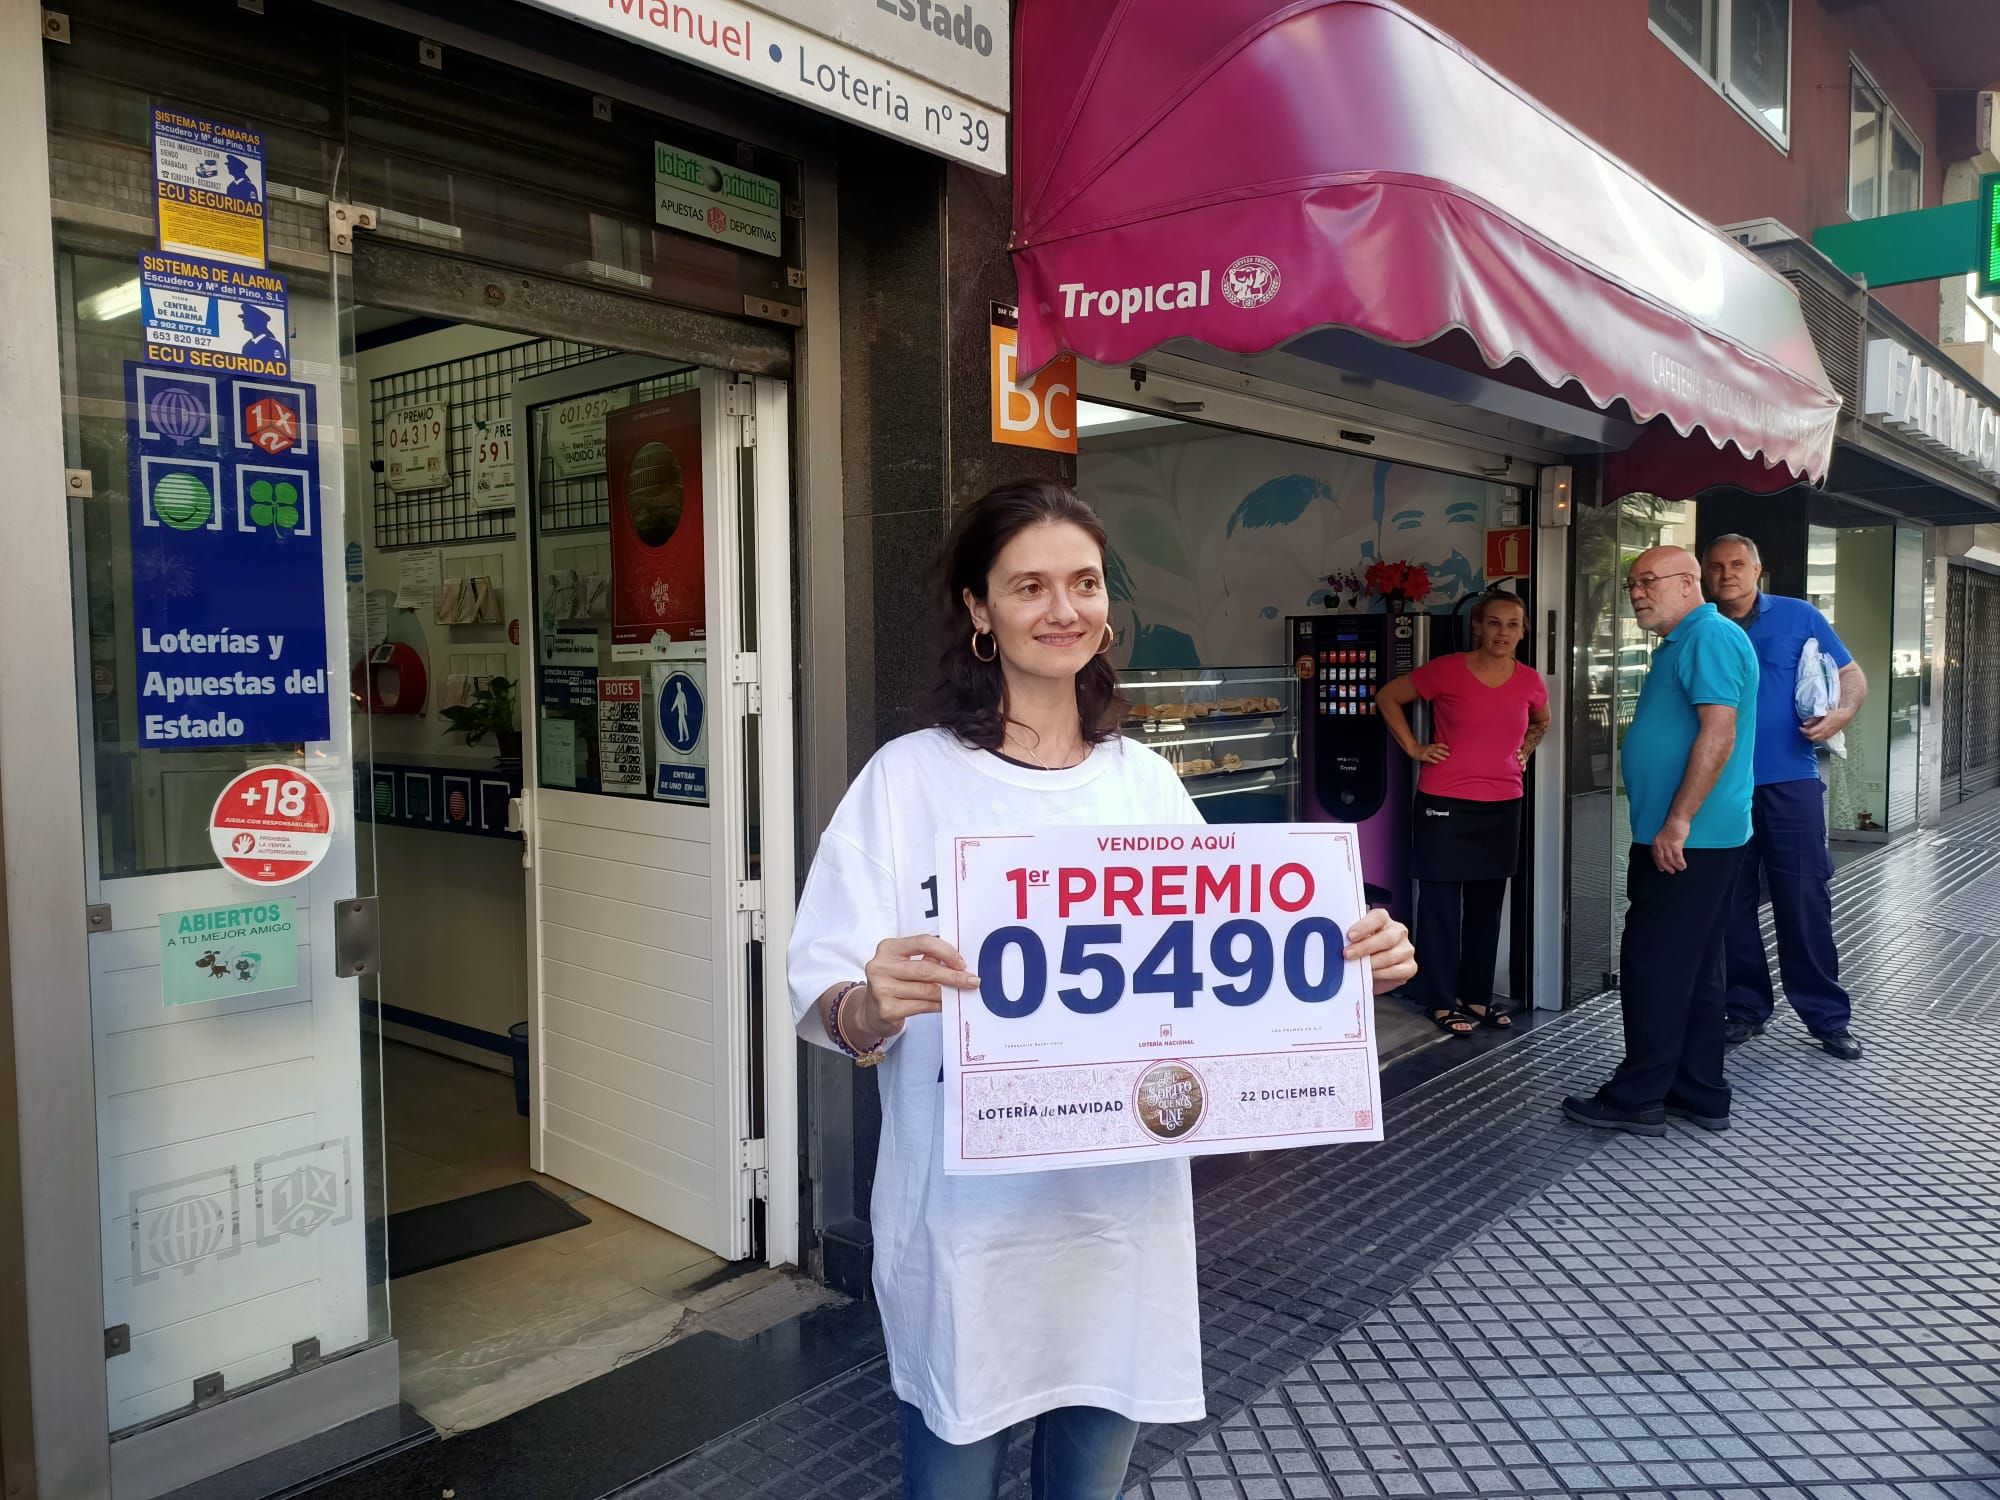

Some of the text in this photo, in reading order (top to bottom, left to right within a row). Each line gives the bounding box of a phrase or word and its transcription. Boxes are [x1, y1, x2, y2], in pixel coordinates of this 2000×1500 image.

[800, 45, 910, 123] Loteria
[959, 112, 990, 152] 39
[154, 110, 260, 145] SISTEMA DE CAMARAS
[155, 121, 193, 138] Escudero
[194, 133, 199, 141] y
[212, 135, 225, 145] del
[226, 138, 245, 152] Pino,
[160, 139, 176, 149] ESTAS
[160, 149, 178, 159] SIENDO
[160, 158, 188, 171] GRABADAS
[158, 182, 263, 217] ECU SEGURIDAD
[660, 199, 705, 221] APUESTAS
[729, 219, 778, 242] DEPORTIVAS
[143, 255, 283, 293] SISTEMAS DE ALARMA
[144, 271, 194, 288] Escudero
[196, 281, 202, 291] y
[205, 281, 219, 291] Mª
[221, 284, 237, 295] del
[238, 287, 264, 300] Pino,
[163, 300, 198, 313] CENTRAL
[1058, 269, 1212, 324] Tropical
[157, 308, 204, 322] DE ALARMA
[160, 320, 212, 335] 902 877 172
[153, 331, 212, 347] 653 820 827
[148, 344, 288, 376] ECU SEGURIDAD
[403, 407, 434, 424] PREMIO
[560, 399, 608, 424] 601.952
[390, 421, 441, 448] 04319
[479, 440, 510, 463] 591
[142, 626, 284, 660] Loterías y
[143, 668, 325, 703] Apuestas del
[604, 682, 635, 696] BOTES
[145, 711, 245, 740] Estado
[240, 778, 307, 818] +18
[660, 780, 669, 789] DE
[669, 781, 682, 790] UNO
[684, 783, 693, 792] EN
[262, 820, 319, 828] RESPONSABILIDAD
[1097, 832, 1236, 851] VENDIDO AQUÍ
[1006, 862, 1316, 919] 1er PREMIO
[178, 904, 281, 934] ABIERTOS
[167, 922, 292, 947] A TU MEJOR AMIGO
[978, 917, 1345, 1019] 05490
[1138, 1040, 1163, 1048] LOTERÍA
[1147, 1080, 1192, 1106] SORTEO
[1159, 1099, 1175, 1110] QUE
[1241, 1086, 1336, 1101] 22 DICIEMBRE
[978, 1100, 1124, 1120] LOTERÍA de NAVIDAD
[1155, 1109, 1185, 1130] UNE
